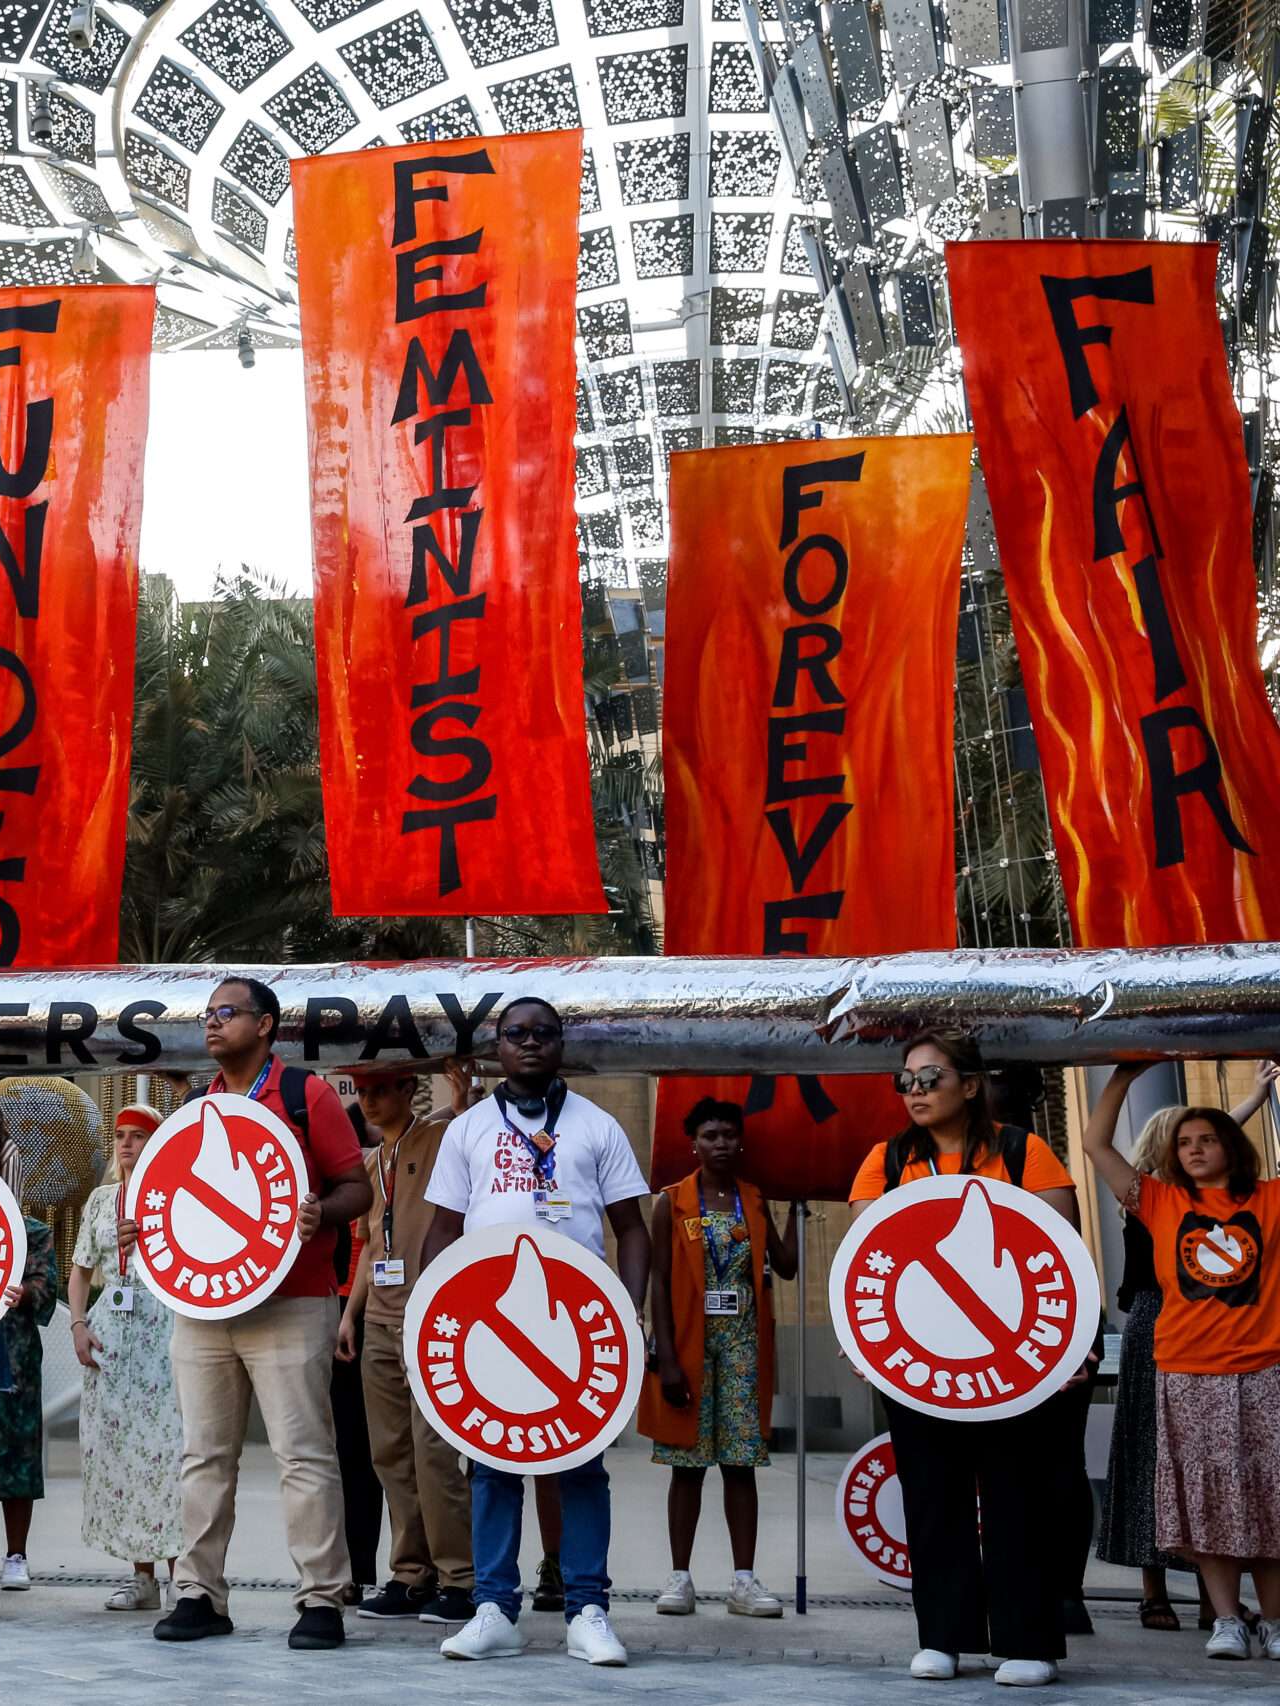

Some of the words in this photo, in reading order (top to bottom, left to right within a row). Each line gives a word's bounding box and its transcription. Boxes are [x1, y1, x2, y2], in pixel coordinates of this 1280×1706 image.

[390, 148, 498, 897] FEMINIST
[1040, 265, 1258, 869] FAIR
[303, 992, 505, 1062] PAY
[142, 1188, 175, 1272] #END
[173, 1256, 267, 1299] FOSSIL
[256, 1142, 293, 1249] FUELS
[427, 1313, 464, 1406] #END
[461, 1407, 581, 1454] FOSSIL
[577, 1300, 620, 1419] FUELS
[854, 1249, 896, 1343] #END
[883, 1347, 1015, 1401] FOSSIL
[1015, 1251, 1068, 1373] FUELS
[849, 1459, 886, 1518] #END
[855, 1524, 912, 1573] FOSS
